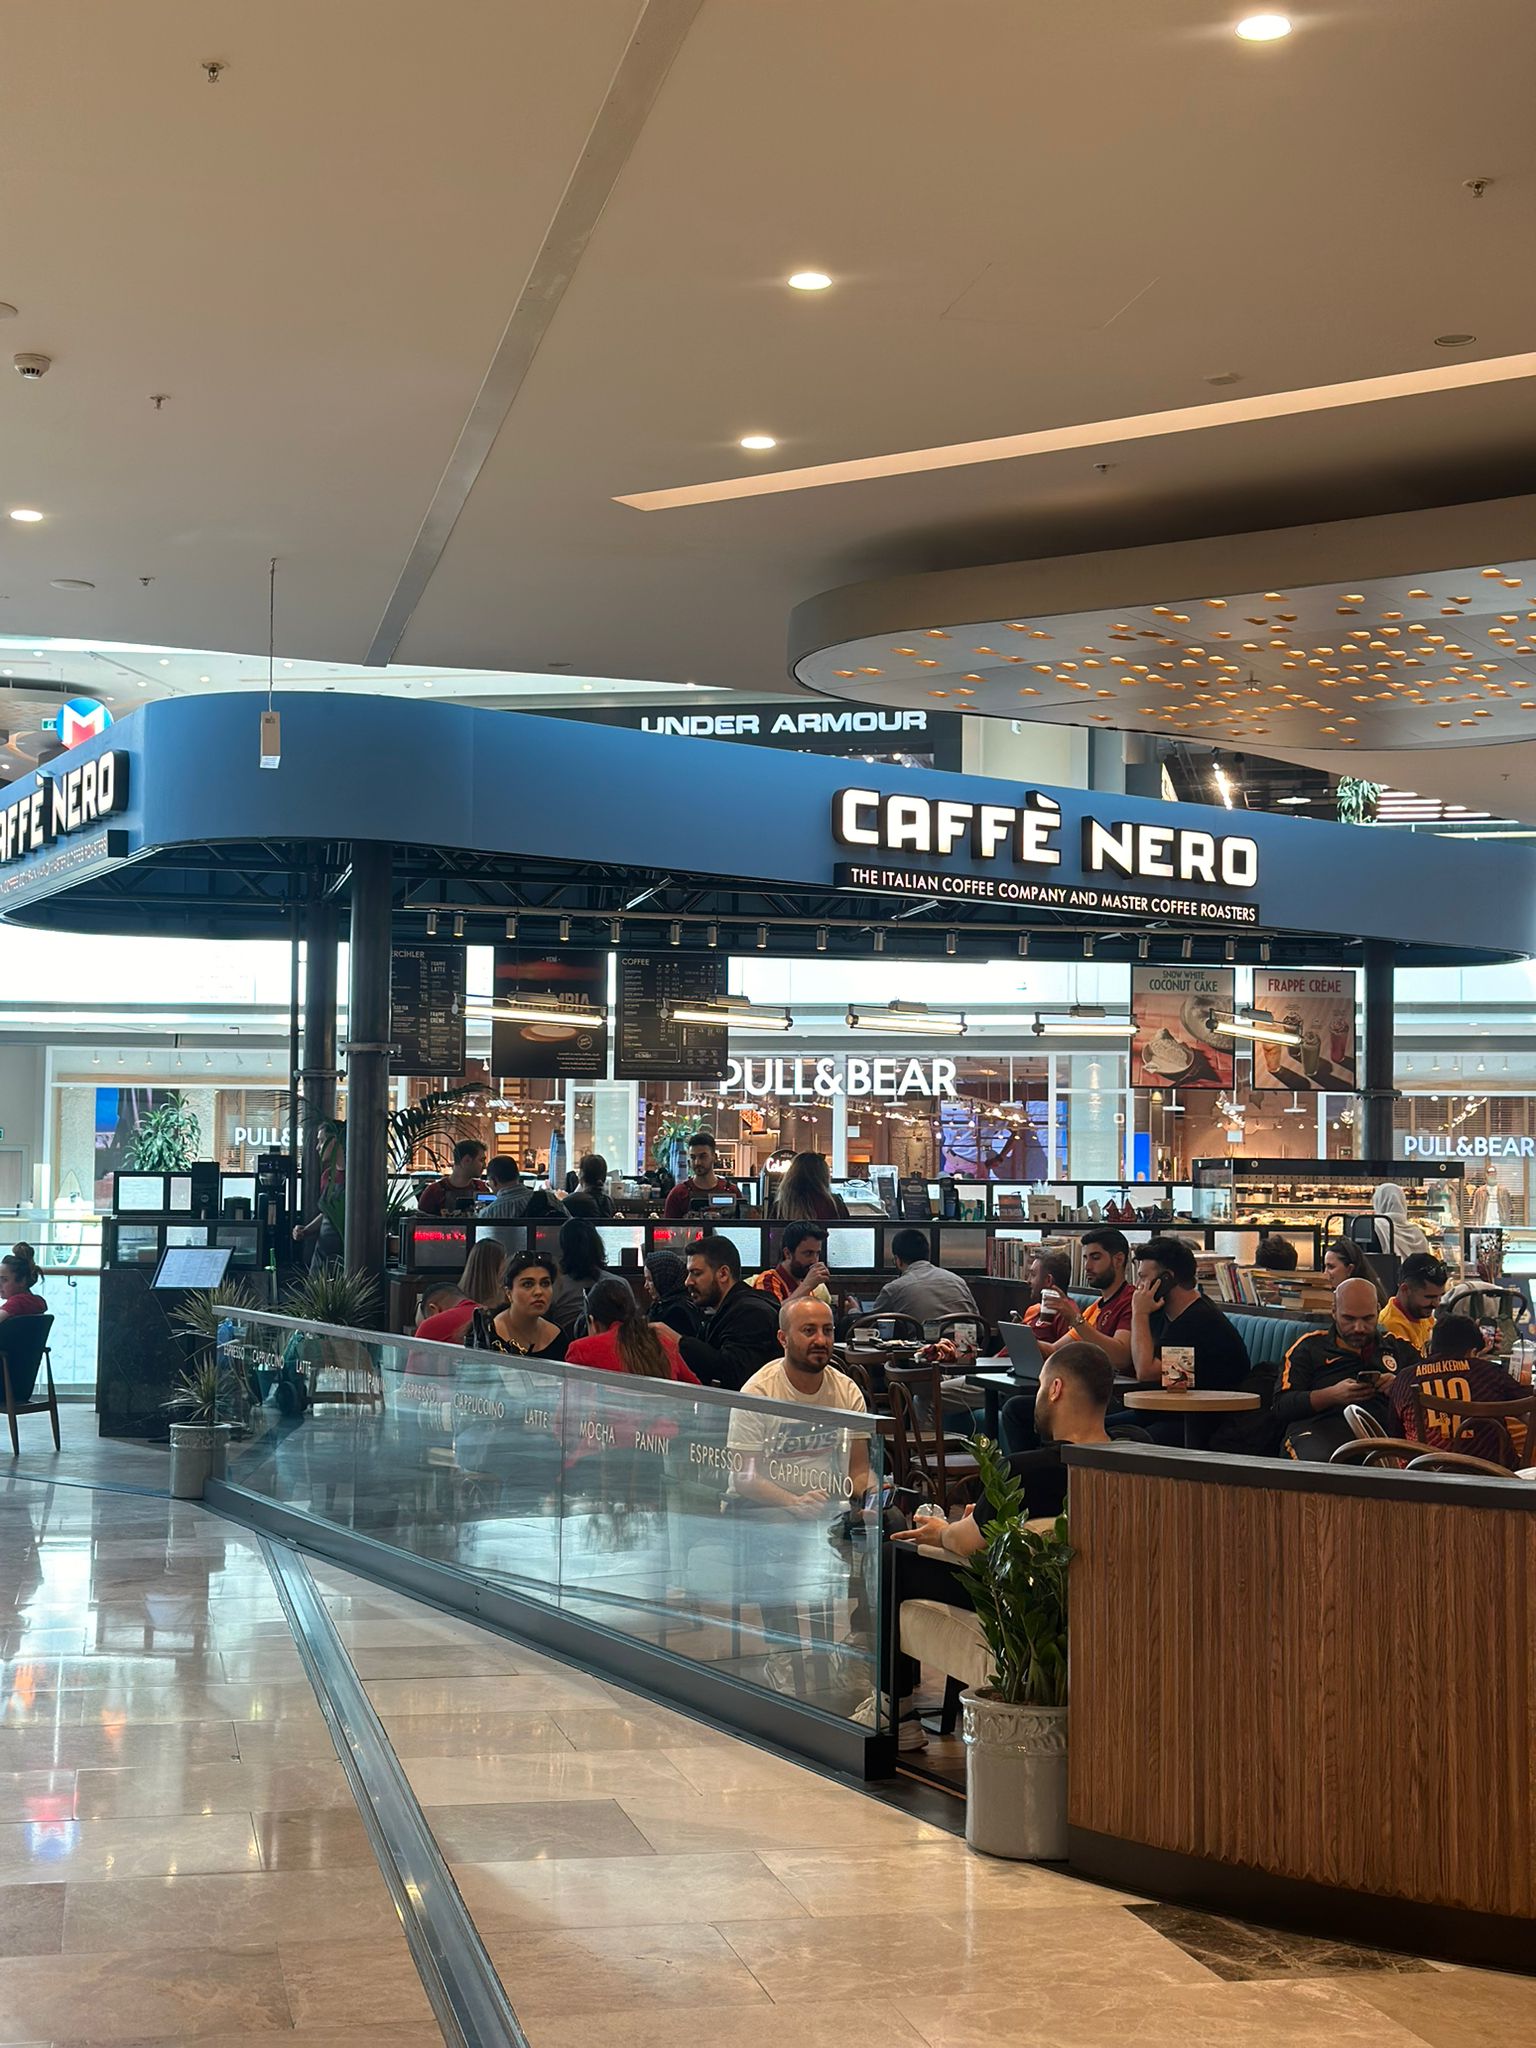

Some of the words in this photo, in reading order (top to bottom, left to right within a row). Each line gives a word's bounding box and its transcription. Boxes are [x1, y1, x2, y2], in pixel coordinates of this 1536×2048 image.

[641, 715, 760, 736] UNDER
[770, 710, 927, 734] ARMOUR
[0, 771, 45, 863] AFFÈ
[52, 751, 115, 837] NERO
[841, 788, 1061, 865] CAFFÈ
[1091, 819, 1258, 888] NERO
[851, 867, 878, 885] THE
[882, 870, 939, 891] ITALIAN
[942, 877, 994, 896] COFFEE
[998, 882, 1067, 904] COMPANY
[1069, 890, 1098, 906] AND
[1101, 893, 1149, 912] MASTER
[1151, 898, 1198, 916] COFFEE
[1200, 903, 1256, 922] ROASTERS
[391, 950, 425, 959] ERCİHLER
[621, 958, 650, 966] COFFEE
[1149, 979, 1191, 992] COCONUT
[1194, 980, 1218, 992] CAKE
[1162, 971, 1182, 979] SNOW
[1184, 971, 1205, 980] WHITE
[1268, 977, 1305, 992] FRAPPÉ
[719, 1057, 958, 1096] PULL&BEAR
[1404, 1136, 1535, 1157] PULL&BEAR
[252, 1350, 285, 1369] CAPPUCCINO
[296, 1359, 312, 1376] LATTE
[454, 1393, 505, 1418] CAPPUCCINO
[524, 1407, 548, 1428] LATTE
[580, 1420, 616, 1444] MOCHA
[635, 1431, 669, 1455] PANINI
[690, 1443, 743, 1472] ESPRESSO
[769, 1459, 854, 1498] CAPPUCCINO
